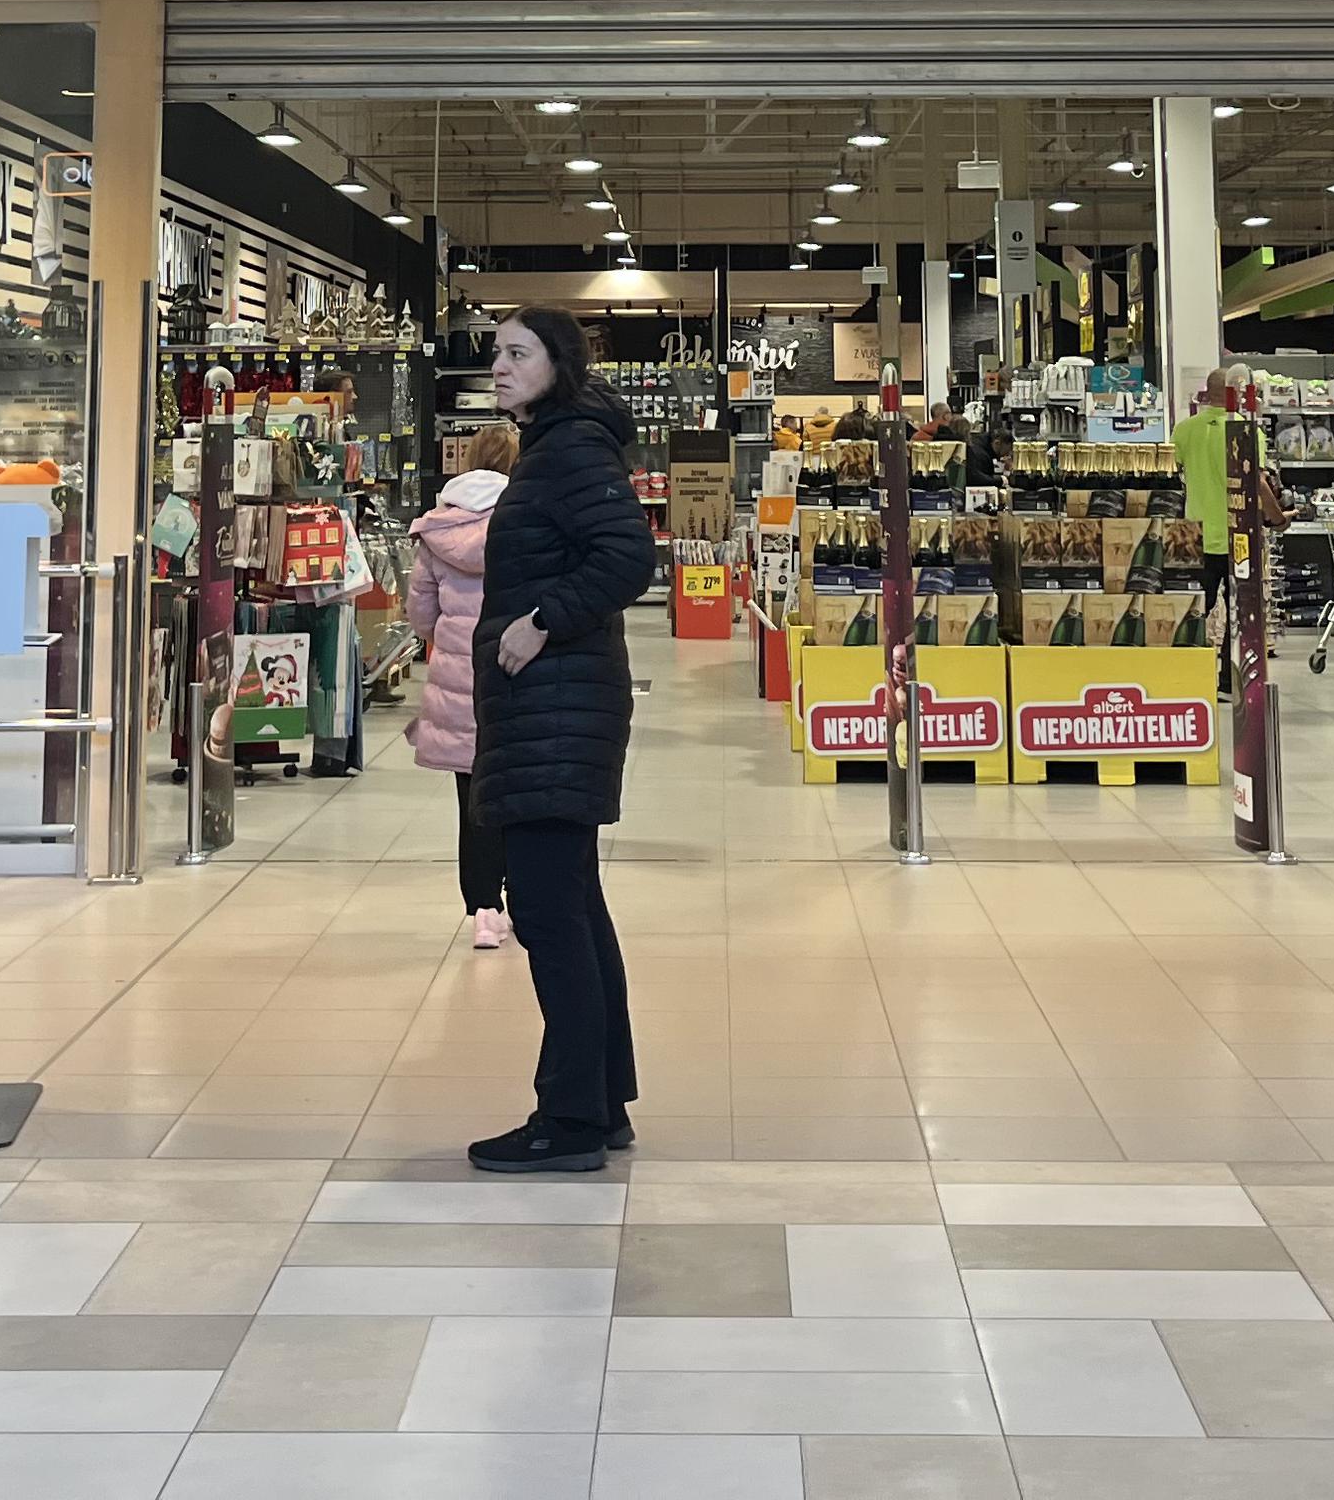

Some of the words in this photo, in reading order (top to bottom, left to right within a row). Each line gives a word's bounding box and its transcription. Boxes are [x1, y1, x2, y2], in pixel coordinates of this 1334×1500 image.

[823, 706, 987, 745] NEPORITELNÉ
[1032, 708, 1198, 746] NEPORAZITELNÉ
[1092, 701, 1135, 715] albert
